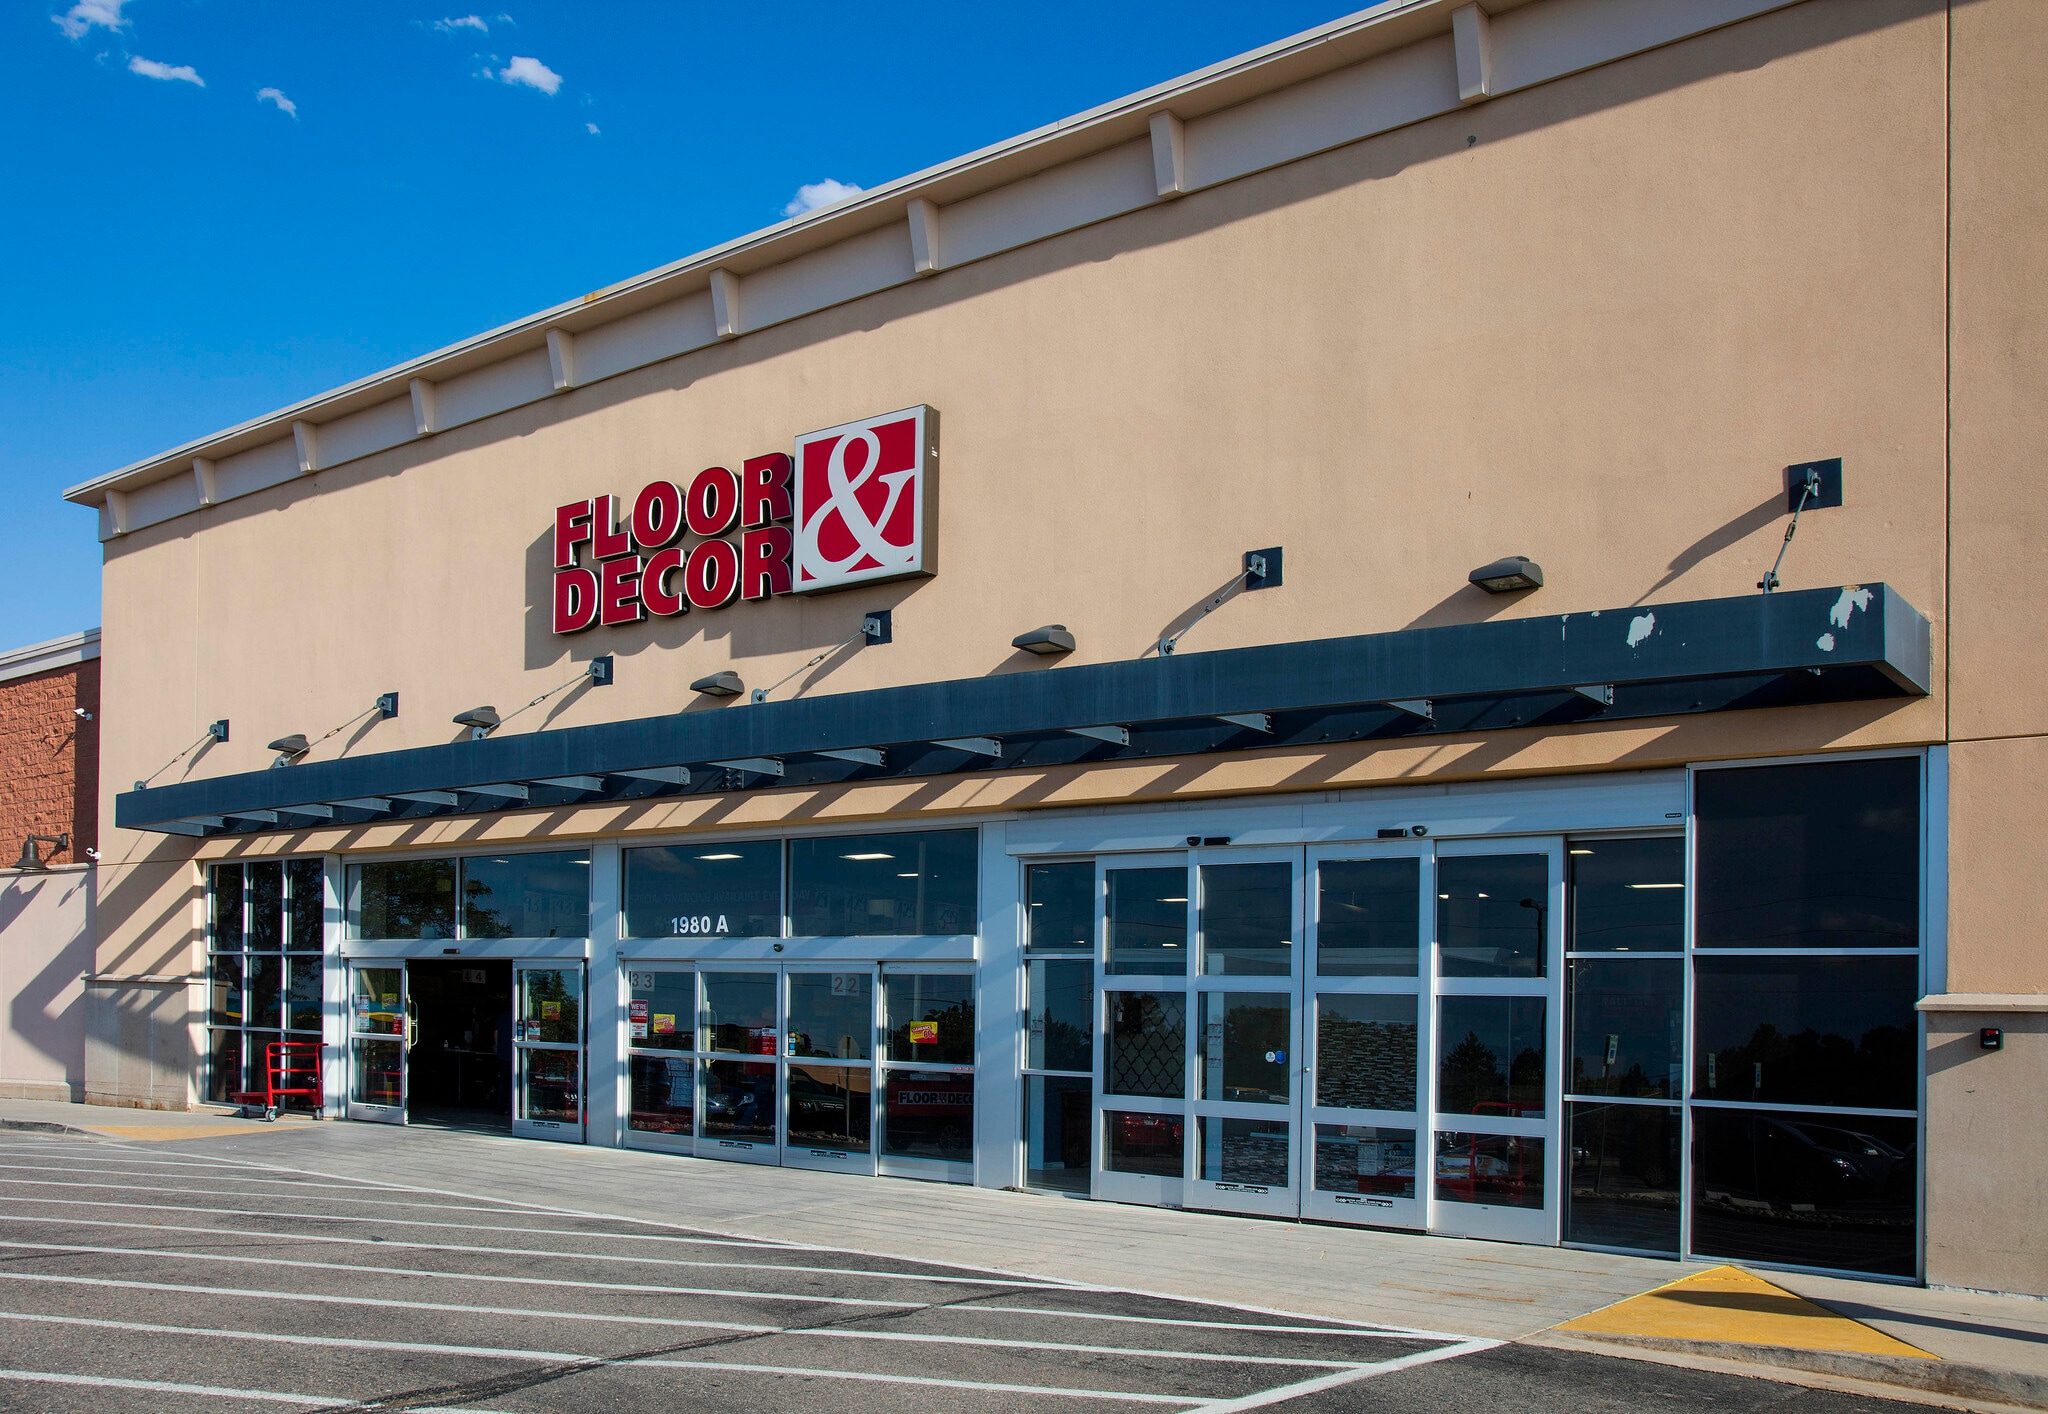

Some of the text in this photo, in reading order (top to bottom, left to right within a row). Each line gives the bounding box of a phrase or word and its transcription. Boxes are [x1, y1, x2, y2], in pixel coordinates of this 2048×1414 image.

[554, 451, 794, 568] FLOOR
[552, 526, 794, 634] DECOR
[671, 914, 729, 934] 1980 A
[834, 976, 857, 993] 2 2
[899, 1092, 938, 1104] FLOOR
